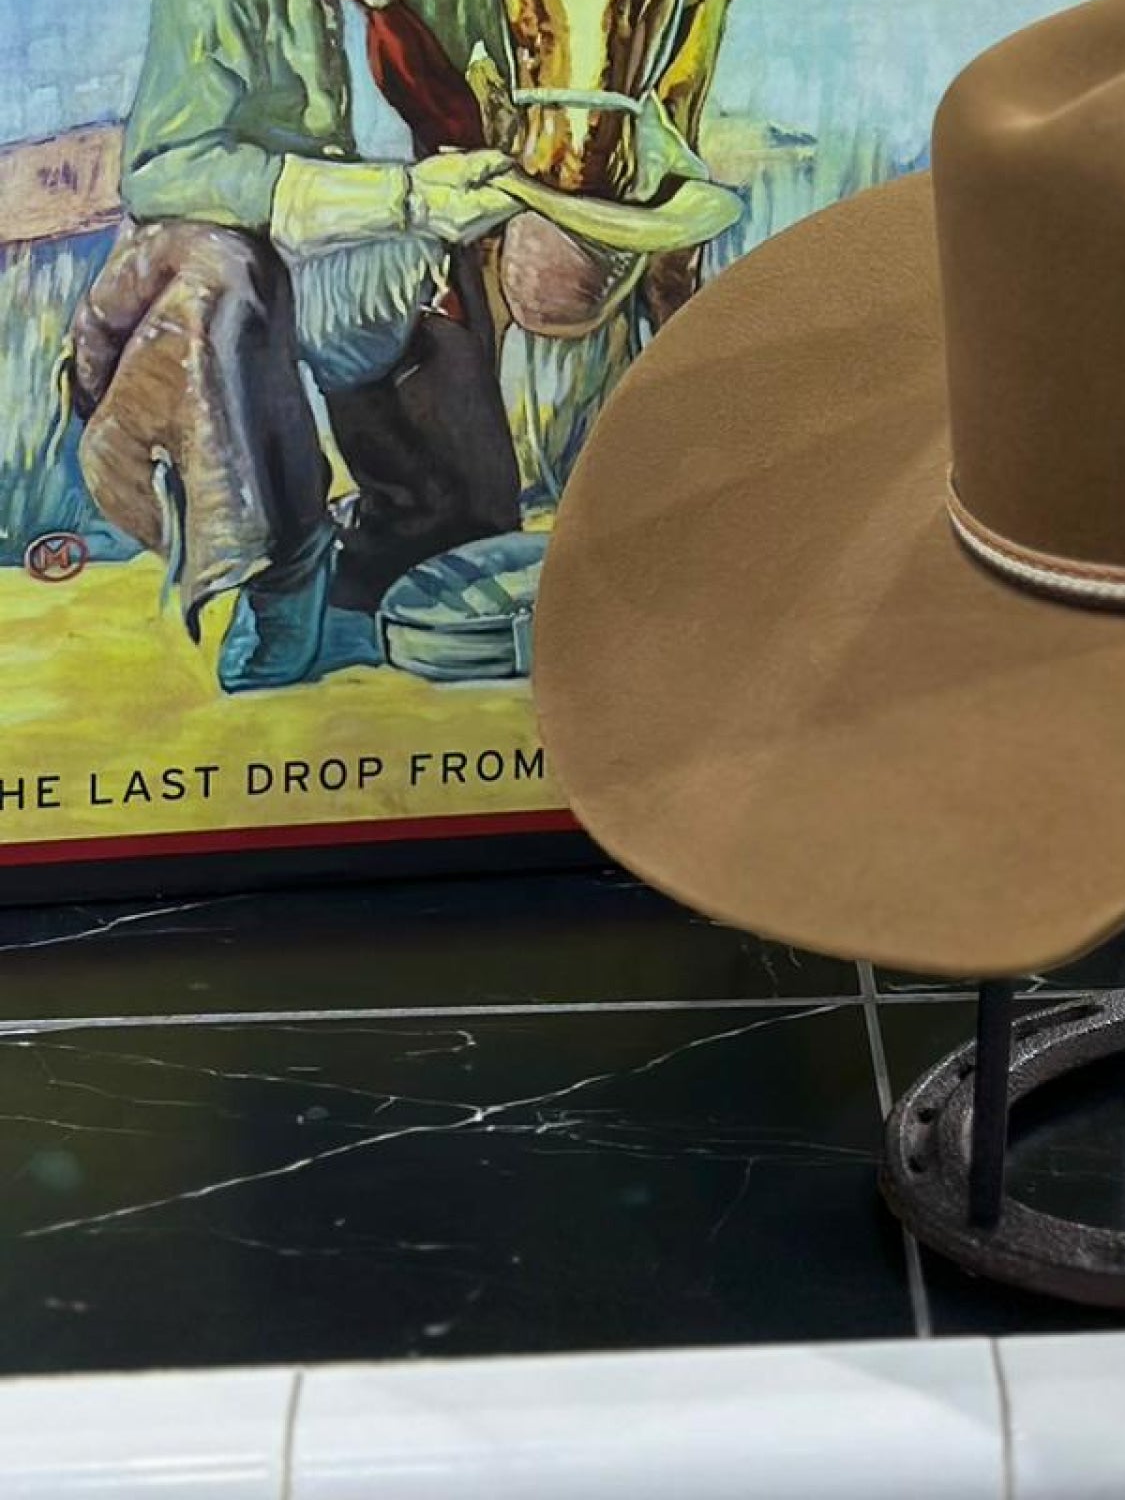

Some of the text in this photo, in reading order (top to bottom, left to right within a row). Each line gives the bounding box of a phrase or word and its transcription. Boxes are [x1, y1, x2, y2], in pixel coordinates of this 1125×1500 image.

[0, 747, 546, 811] HE LAST DROP FROM
